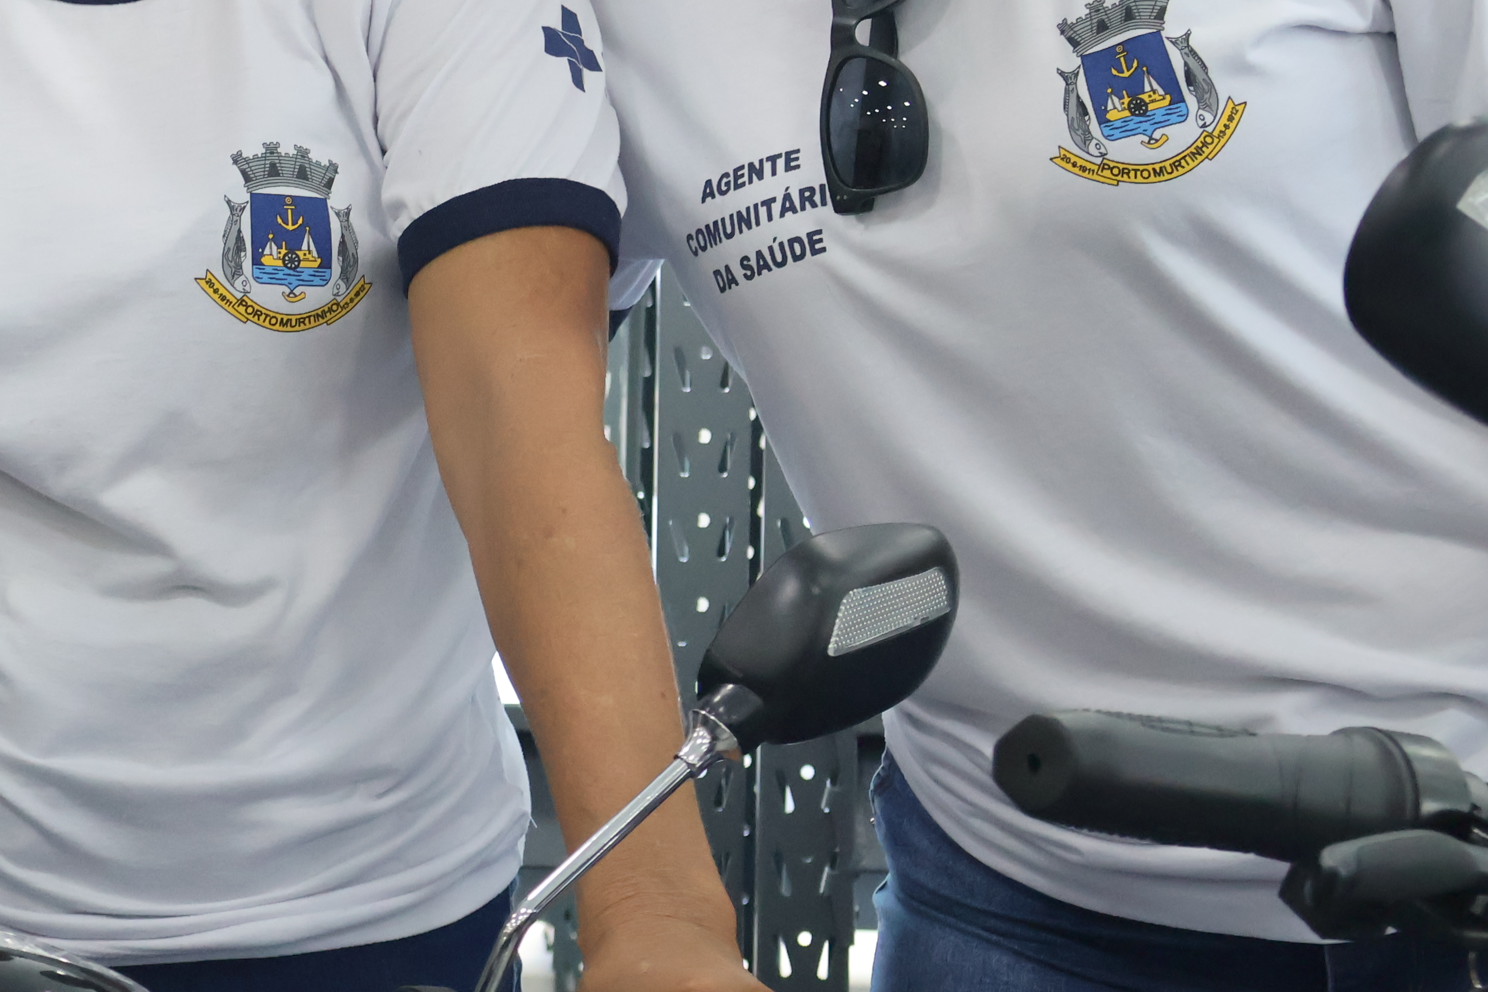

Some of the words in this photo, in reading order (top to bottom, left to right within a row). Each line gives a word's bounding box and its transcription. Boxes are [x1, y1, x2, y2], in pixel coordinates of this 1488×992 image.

[700, 148, 802, 205] AGENTE
[1100, 162, 1152, 181] PORTO
[1153, 134, 1215, 179] MURTINHO
[686, 183, 829, 258] COMUNITÁRI
[712, 264, 740, 294] DA
[739, 229, 828, 282] SAÚDE
[237, 298, 279, 327] PORTO
[278, 302, 340, 329] MURTINHO
